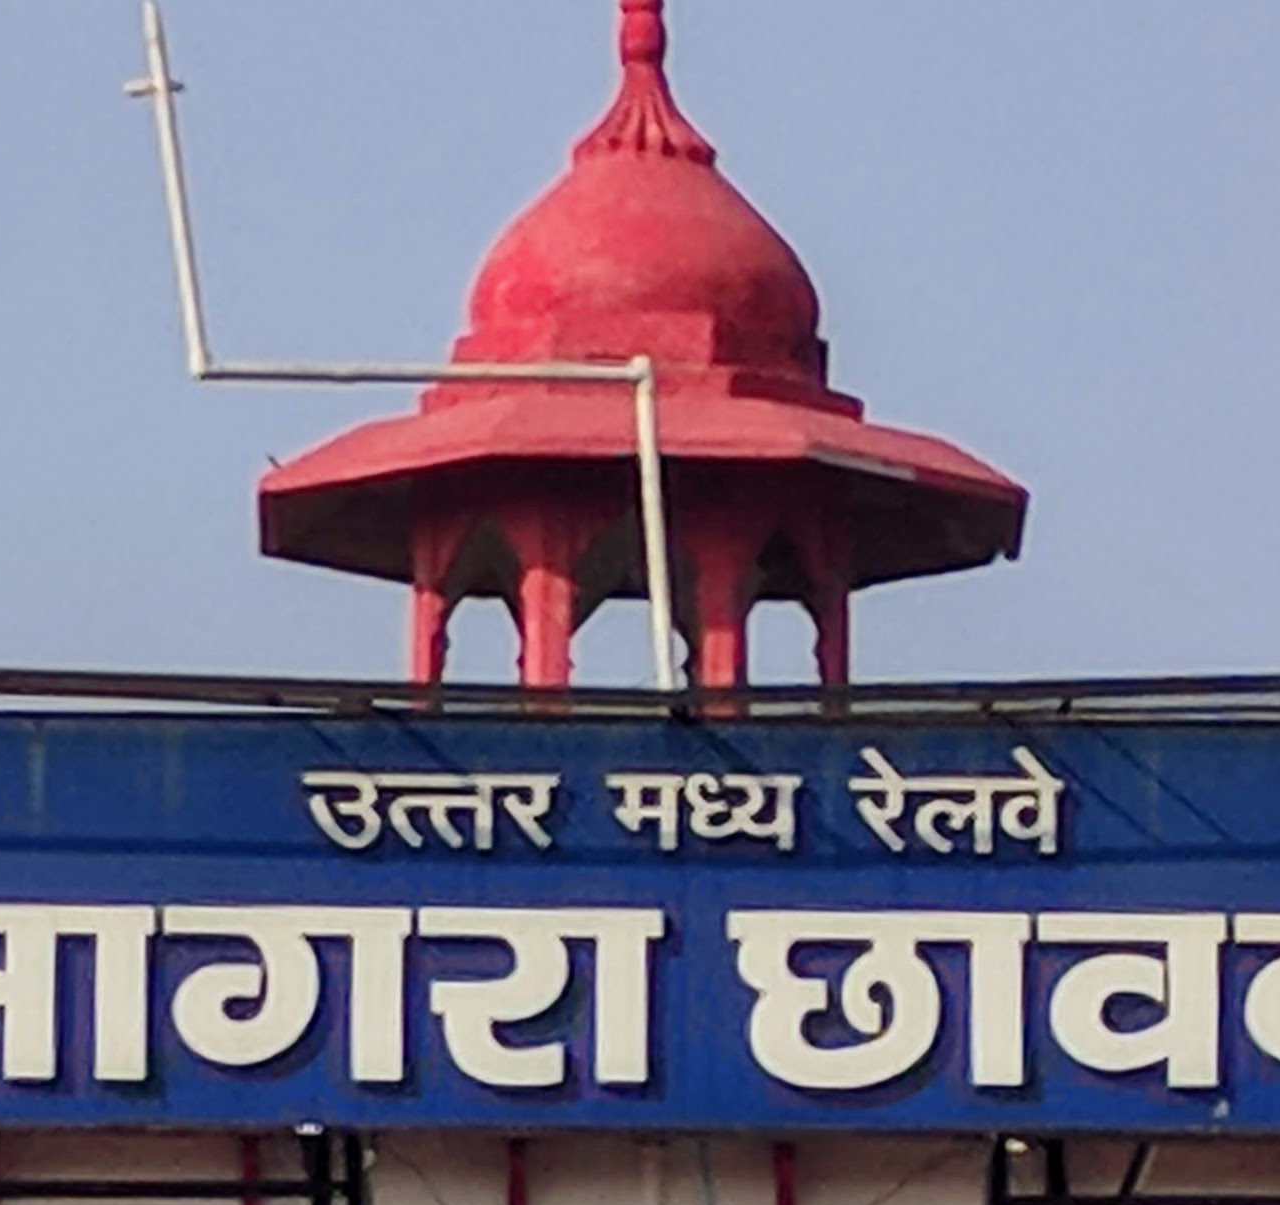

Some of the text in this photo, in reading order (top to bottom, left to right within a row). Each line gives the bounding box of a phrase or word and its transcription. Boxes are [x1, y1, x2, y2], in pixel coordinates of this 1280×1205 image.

[301, 745, 1066, 856] उत्तर मध्य रेलवे
